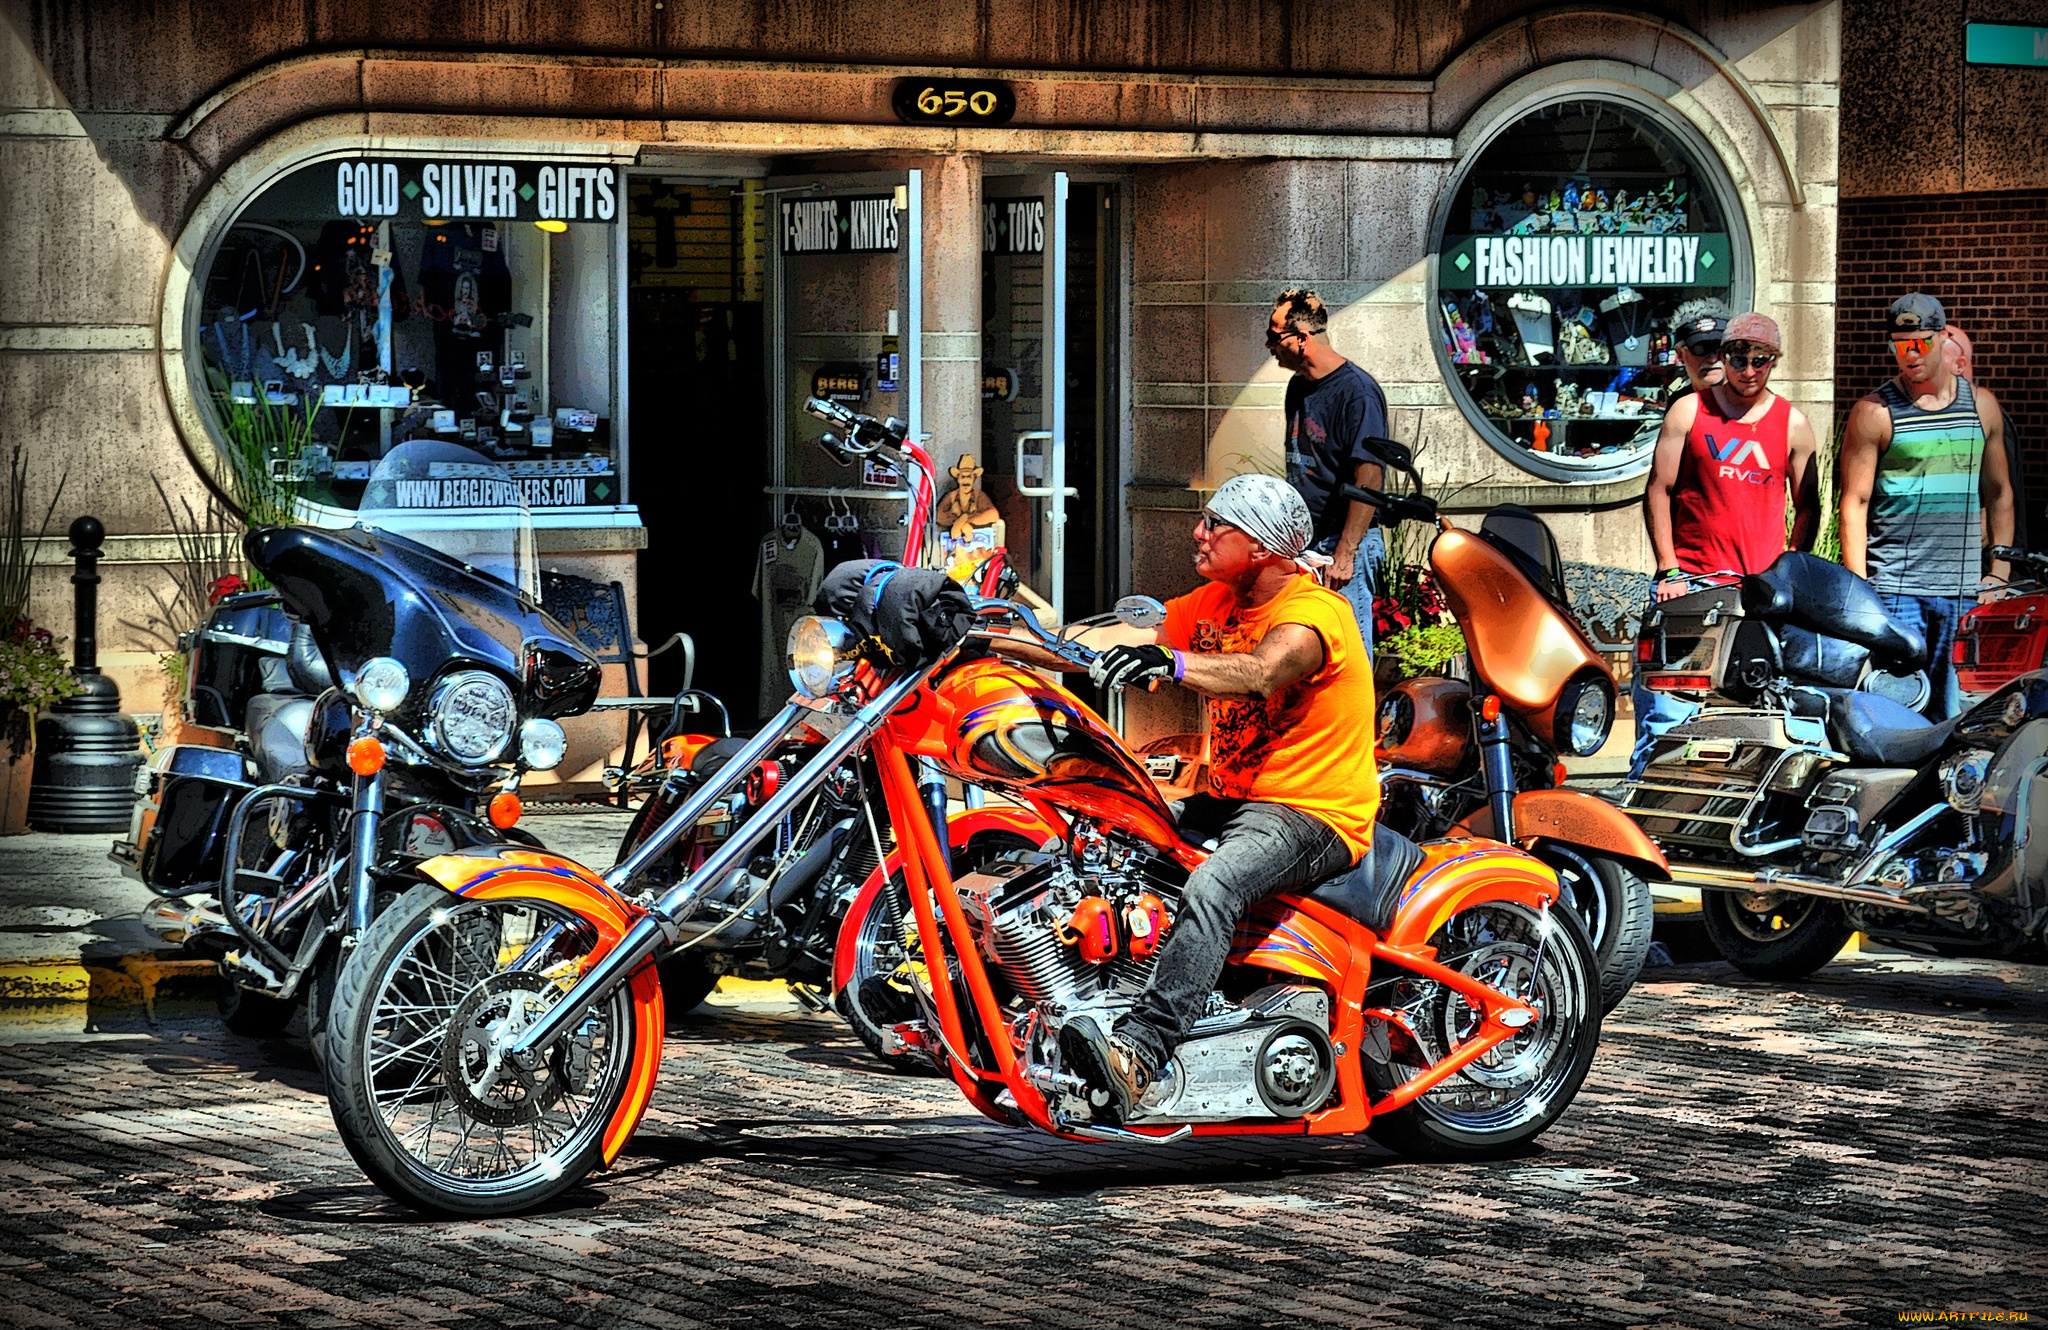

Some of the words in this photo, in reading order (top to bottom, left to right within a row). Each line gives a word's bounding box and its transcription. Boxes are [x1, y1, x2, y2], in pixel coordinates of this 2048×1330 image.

[917, 87, 997, 117] 650
[337, 162, 399, 216] GOLD
[422, 163, 517, 217] SILVER
[538, 166, 615, 220] GIFTS
[782, 200, 838, 251] T-SHIRTS
[850, 198, 898, 250] KNIVES
[1007, 201, 1044, 252] TOYS
[1475, 236, 1586, 287] FASHION
[1589, 236, 1700, 284] JEWELRY
[817, 377, 859, 391] BERG
[1718, 465, 1775, 485] RVCA
[352, 1082, 377, 1138] AVON
